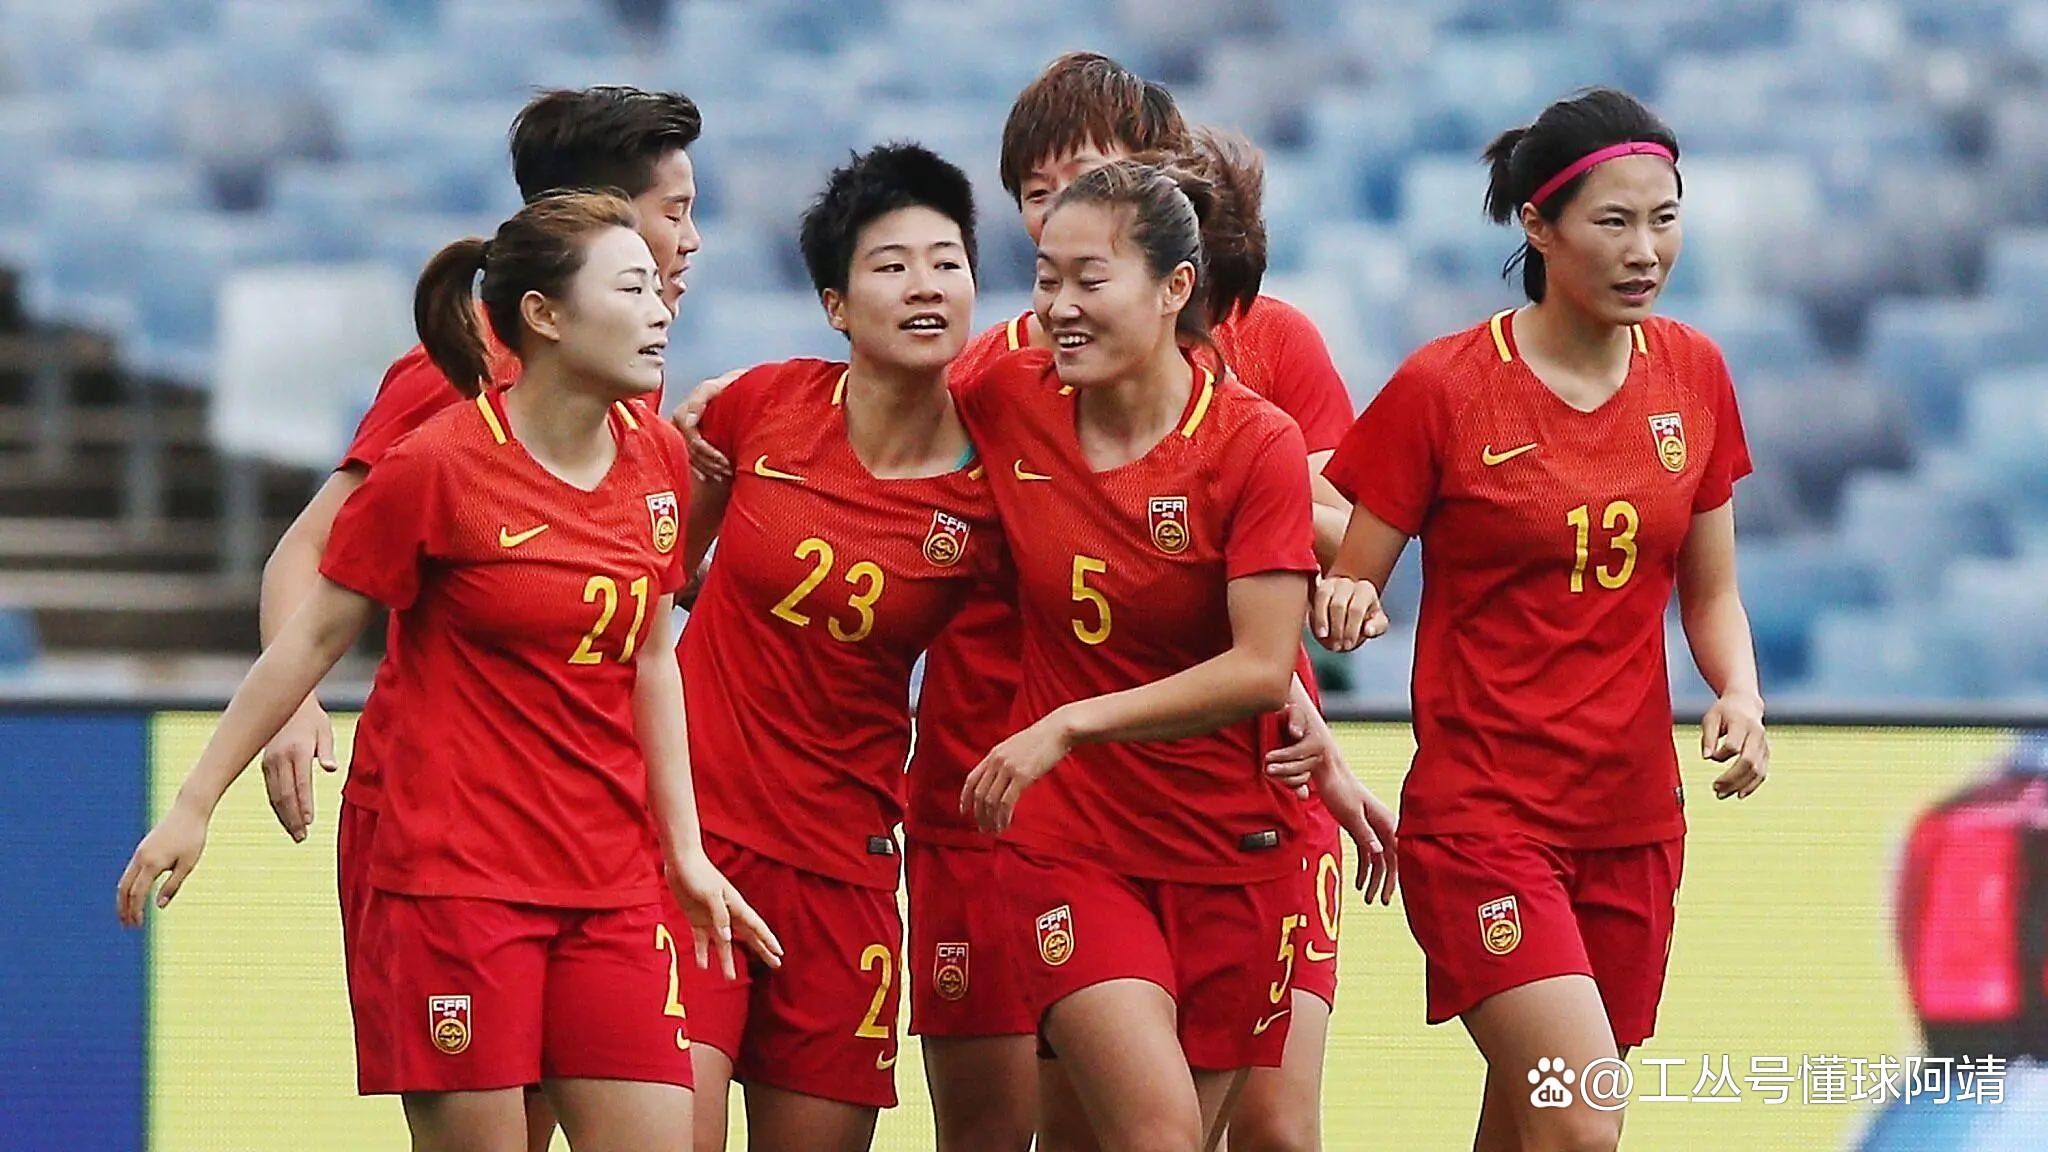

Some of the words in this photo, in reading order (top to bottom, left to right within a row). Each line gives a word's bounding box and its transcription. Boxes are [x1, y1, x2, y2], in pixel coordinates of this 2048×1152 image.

[1652, 416, 1681, 430] CFA
[650, 496, 675, 511] CFA
[937, 512, 968, 533] CFA
[1152, 500, 1185, 513] CFA
[1566, 500, 1640, 593] 13
[770, 537, 886, 644] 23
[1071, 554, 1113, 646] 5
[567, 575, 650, 666] 21
[1039, 909, 1067, 931] CFA
[1300, 853, 1340, 941] 0
[1481, 899, 1513, 920] CFA
[655, 923, 687, 1018] 2
[938, 946, 966, 958] CFA
[1269, 914, 1299, 1003] 5
[433, 999, 467, 1011] CFA
[855, 943, 892, 1038] 2
